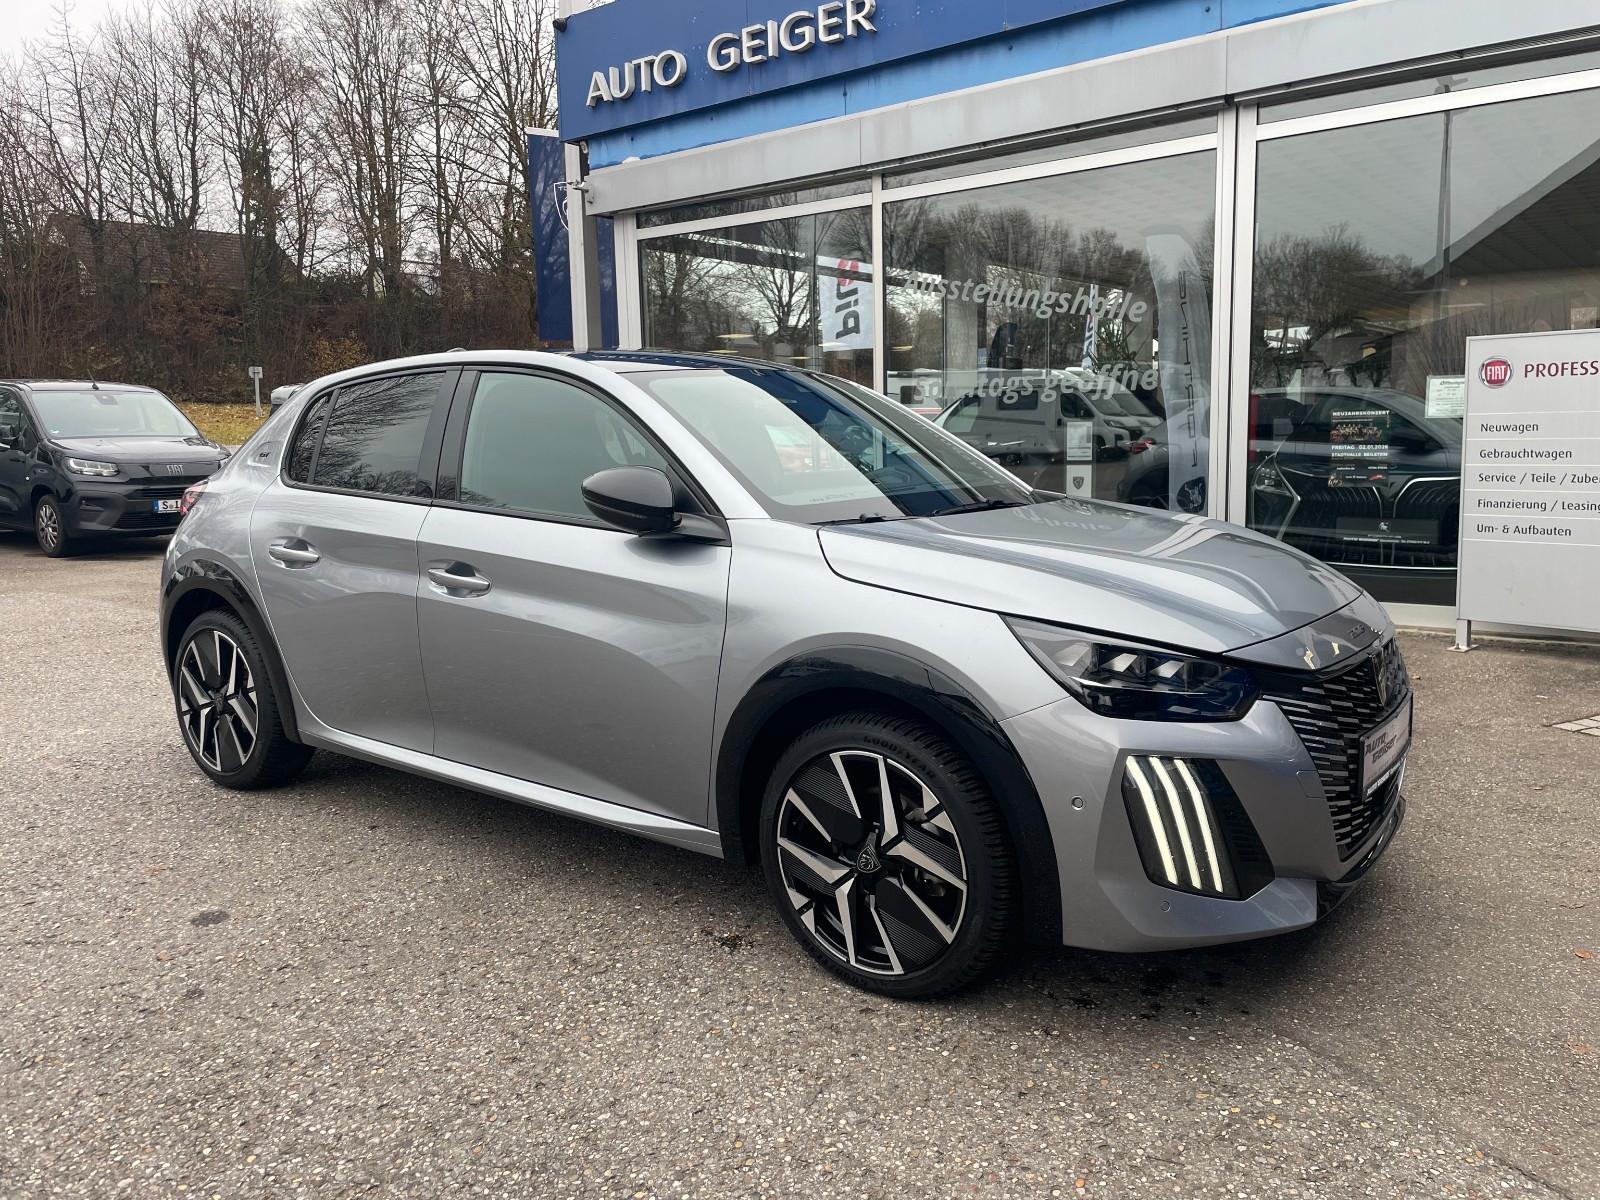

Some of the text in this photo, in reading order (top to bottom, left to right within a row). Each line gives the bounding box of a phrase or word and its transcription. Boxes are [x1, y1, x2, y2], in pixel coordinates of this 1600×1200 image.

[586, 0, 878, 107] AUTO GEIGER
[901, 270, 1148, 324] Ausstellungshalle
[1487, 360, 1600, 381] FIAT PROFESS
[1480, 423, 1539, 434] Neuwagen
[1479, 448, 1572, 460] Gebrauchtwagen
[166, 464, 184, 476] FIAT
[1478, 472, 1600, 485] Service / Teile / Zube
[1477, 499, 1547, 512] Finanzierung
[1550, 500, 1558, 512] /
[1476, 523, 1572, 536] Um- & Aufbauten
